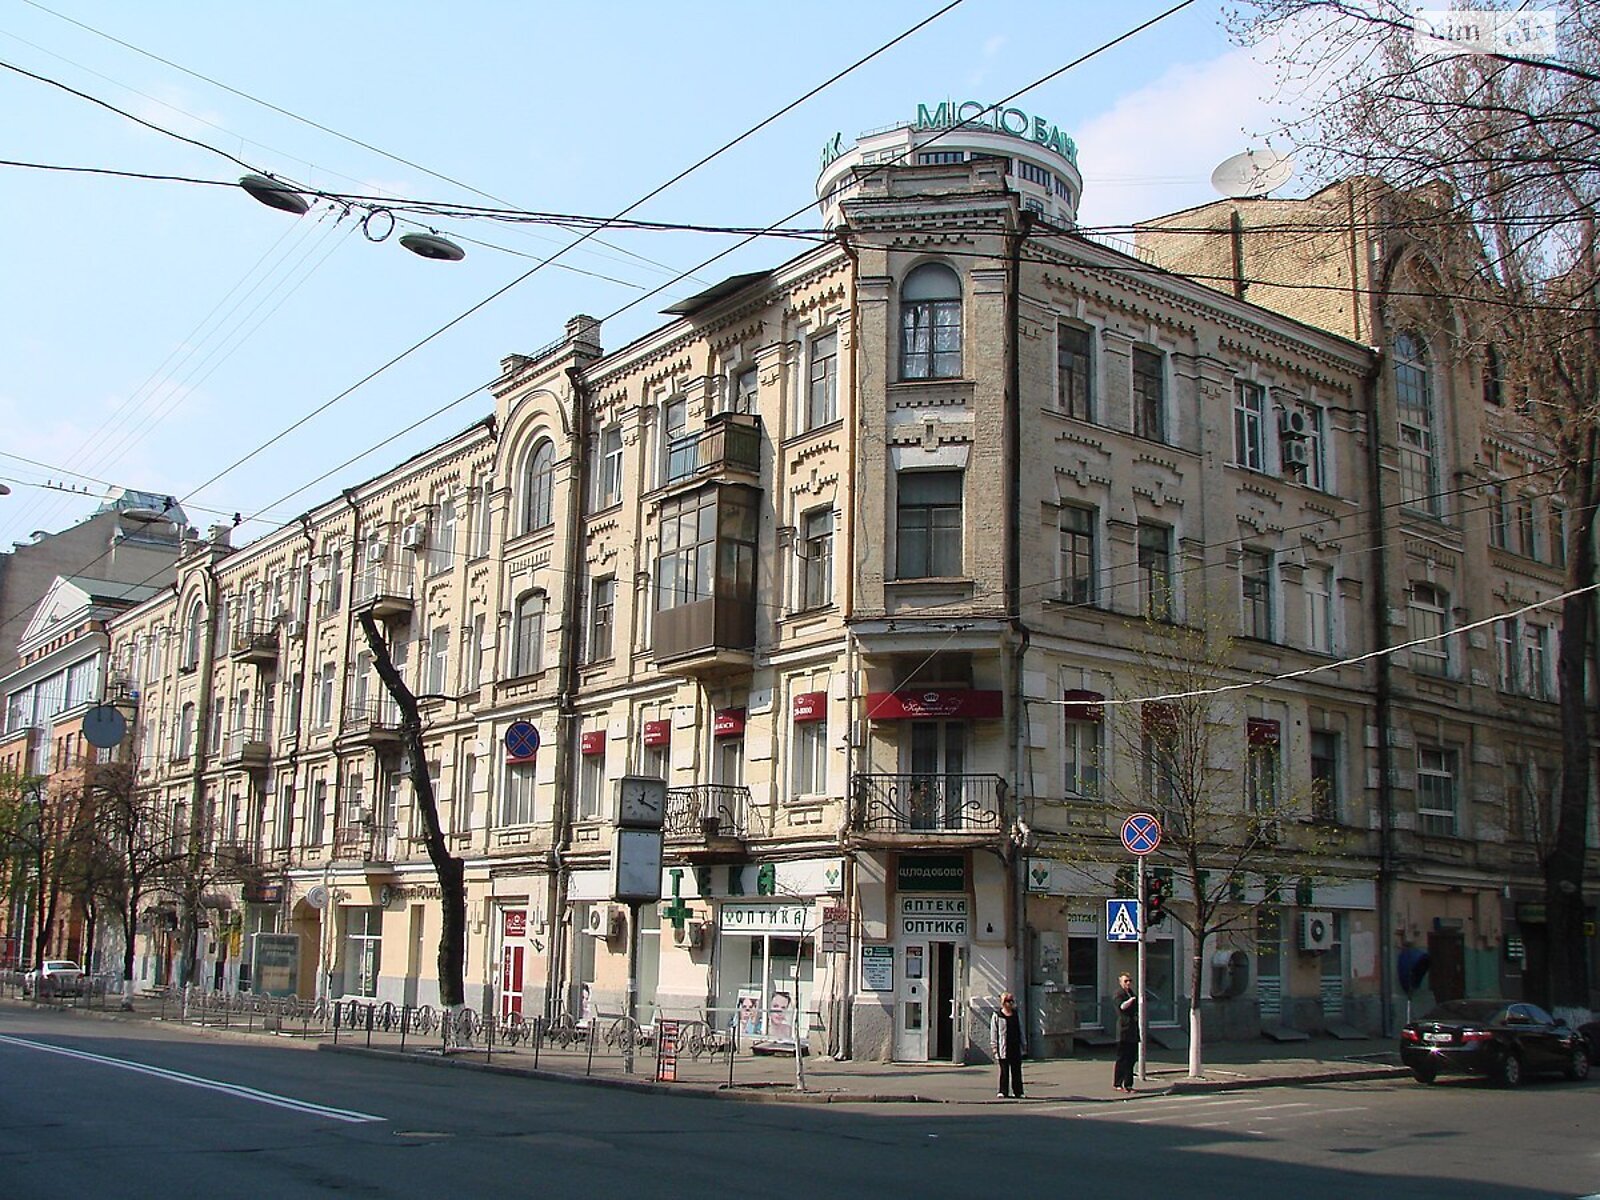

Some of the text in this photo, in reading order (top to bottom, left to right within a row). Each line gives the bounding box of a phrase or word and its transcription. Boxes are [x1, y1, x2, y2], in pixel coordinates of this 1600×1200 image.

[904, 900, 965, 911] АПТЕКА
[735, 909, 801, 925] ОПТИКА
[904, 920, 965, 933] ОПТИКА
